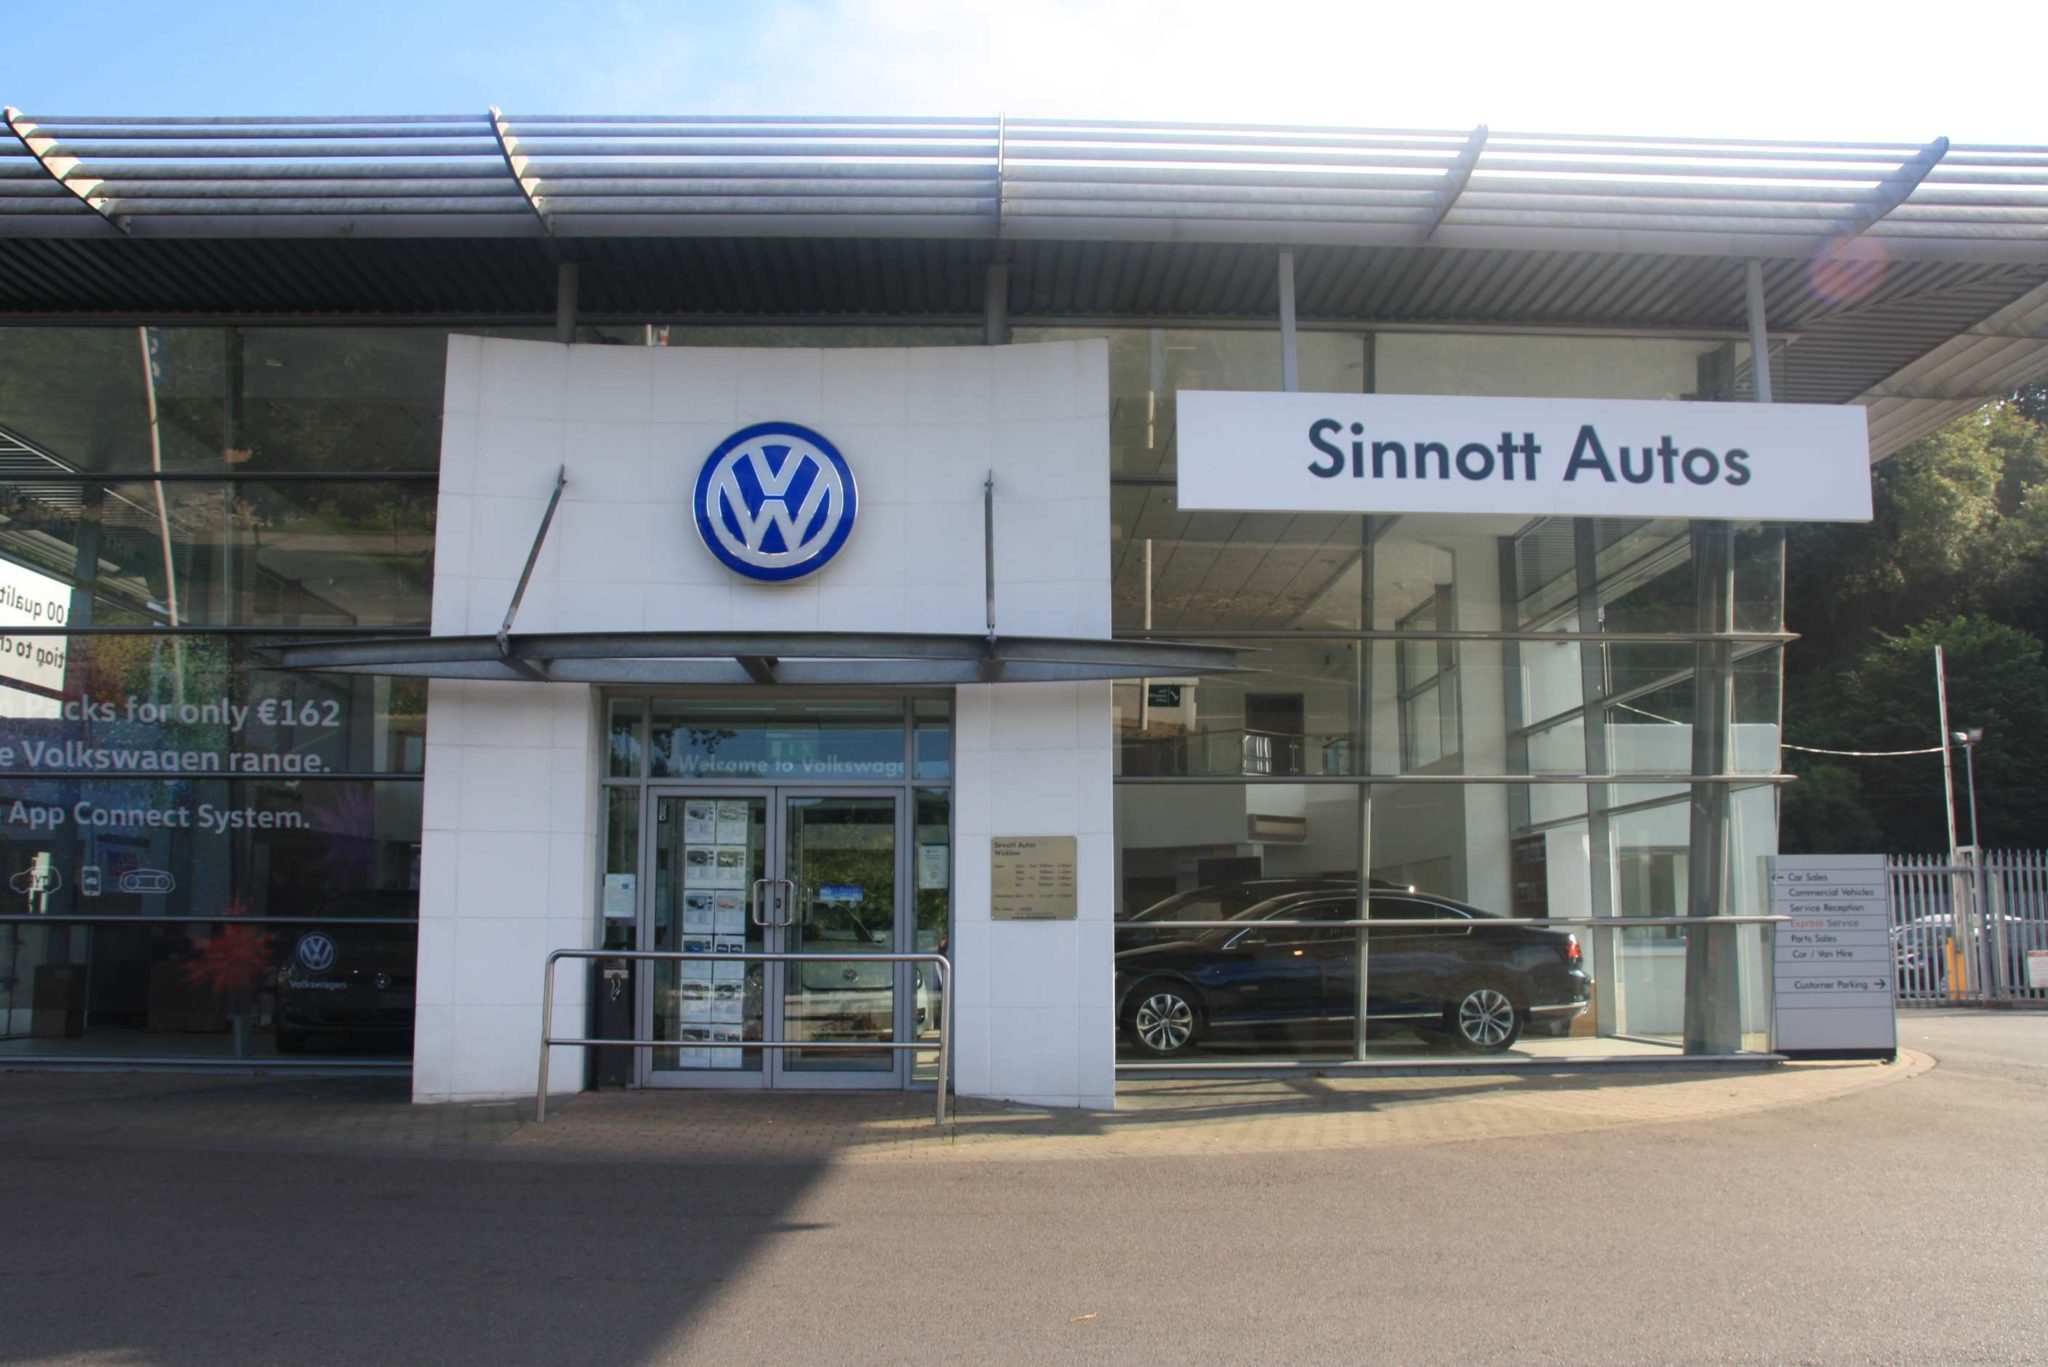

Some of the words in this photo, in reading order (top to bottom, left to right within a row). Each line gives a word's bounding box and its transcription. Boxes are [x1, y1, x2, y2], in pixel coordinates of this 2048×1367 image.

[1307, 418, 1542, 481] Sinnott
[1563, 425, 1751, 487] Autos
[125, 695, 171, 723] for
[179, 697, 249, 732] only
[257, 698, 340, 727] €162
[21, 740, 219, 786] Volkswagen
[229, 751, 331, 787] range.
[679, 754, 769, 773] Welcome
[775, 759, 794, 773] to
[802, 755, 905, 777] Volkswage
[8, 801, 65, 830] App
[73, 801, 190, 828] Connect
[197, 804, 311, 834] System.
[1788, 873, 1802, 882] Car
[1806, 872, 1828, 882] Sales
[1788, 888, 1838, 897] Commercial
[1841, 887, 1874, 896] Vehicles
[1790, 903, 1821, 912] Service
[1823, 903, 1864, 913] Reception
[1791, 919, 1824, 930] Express
[1827, 918, 1859, 928] Service
[1791, 934, 1812, 943] Parts
[1815, 934, 1837, 943] Sales
[1792, 949, 1807, 959] Car
[1817, 949, 1834, 959] Van
[1836, 949, 1853, 958] Hire
[1794, 980, 1834, 990] Customer
[1837, 980, 1868, 990] Parking
